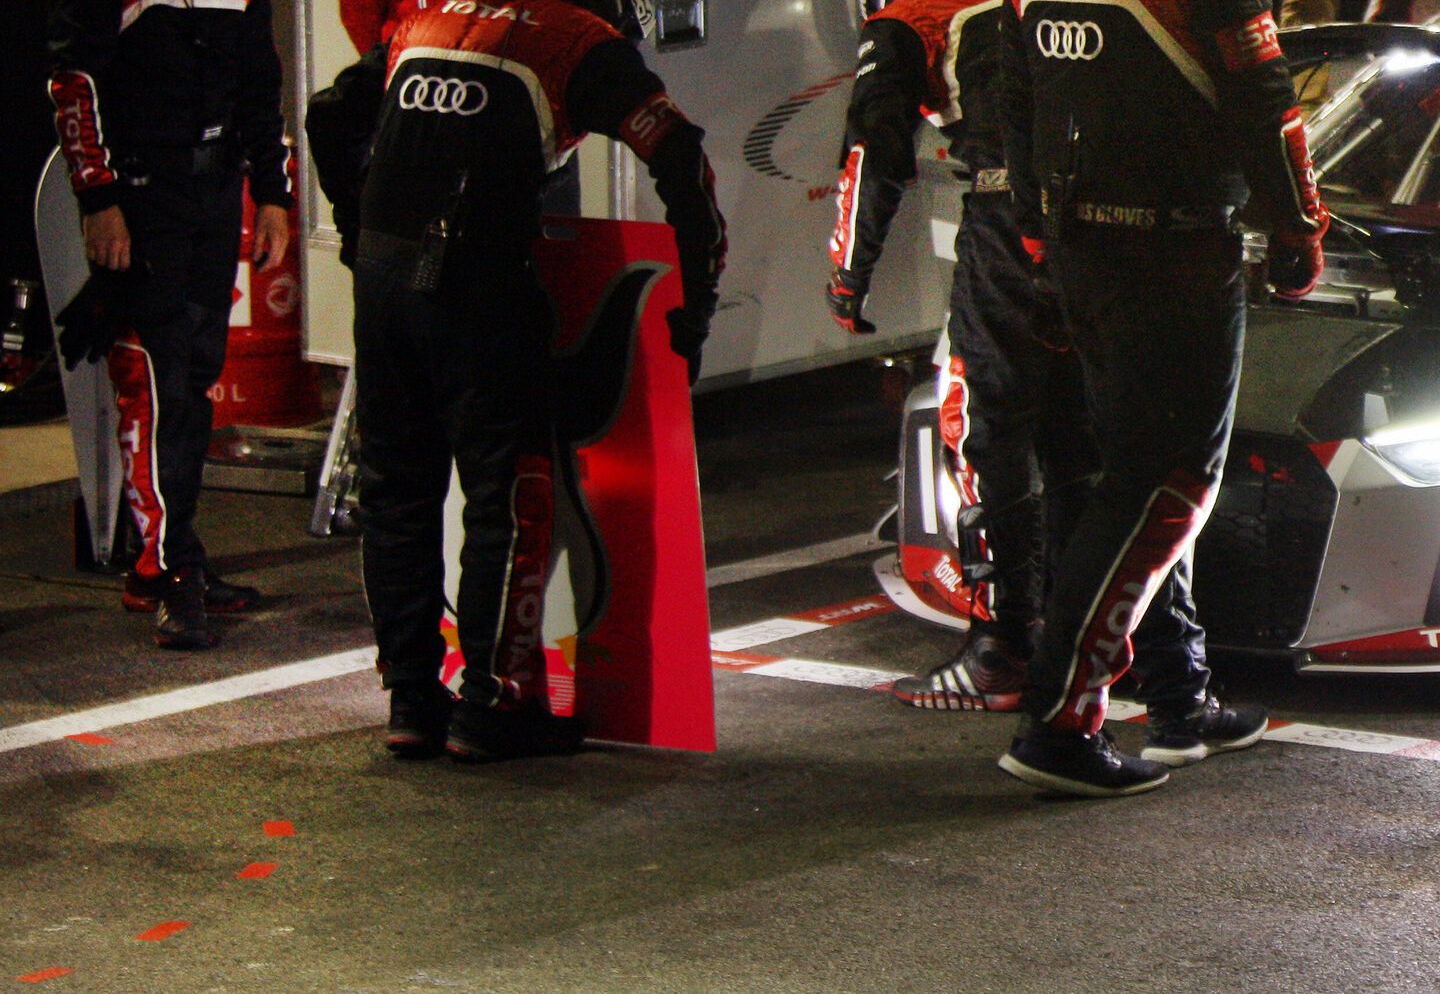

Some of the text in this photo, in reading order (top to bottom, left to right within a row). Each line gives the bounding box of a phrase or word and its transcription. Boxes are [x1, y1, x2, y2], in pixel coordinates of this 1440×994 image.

[441, 0, 540, 26] TOTAL
[932, 553, 963, 594] TOTAL
[1073, 581, 1148, 717] TOTAL
